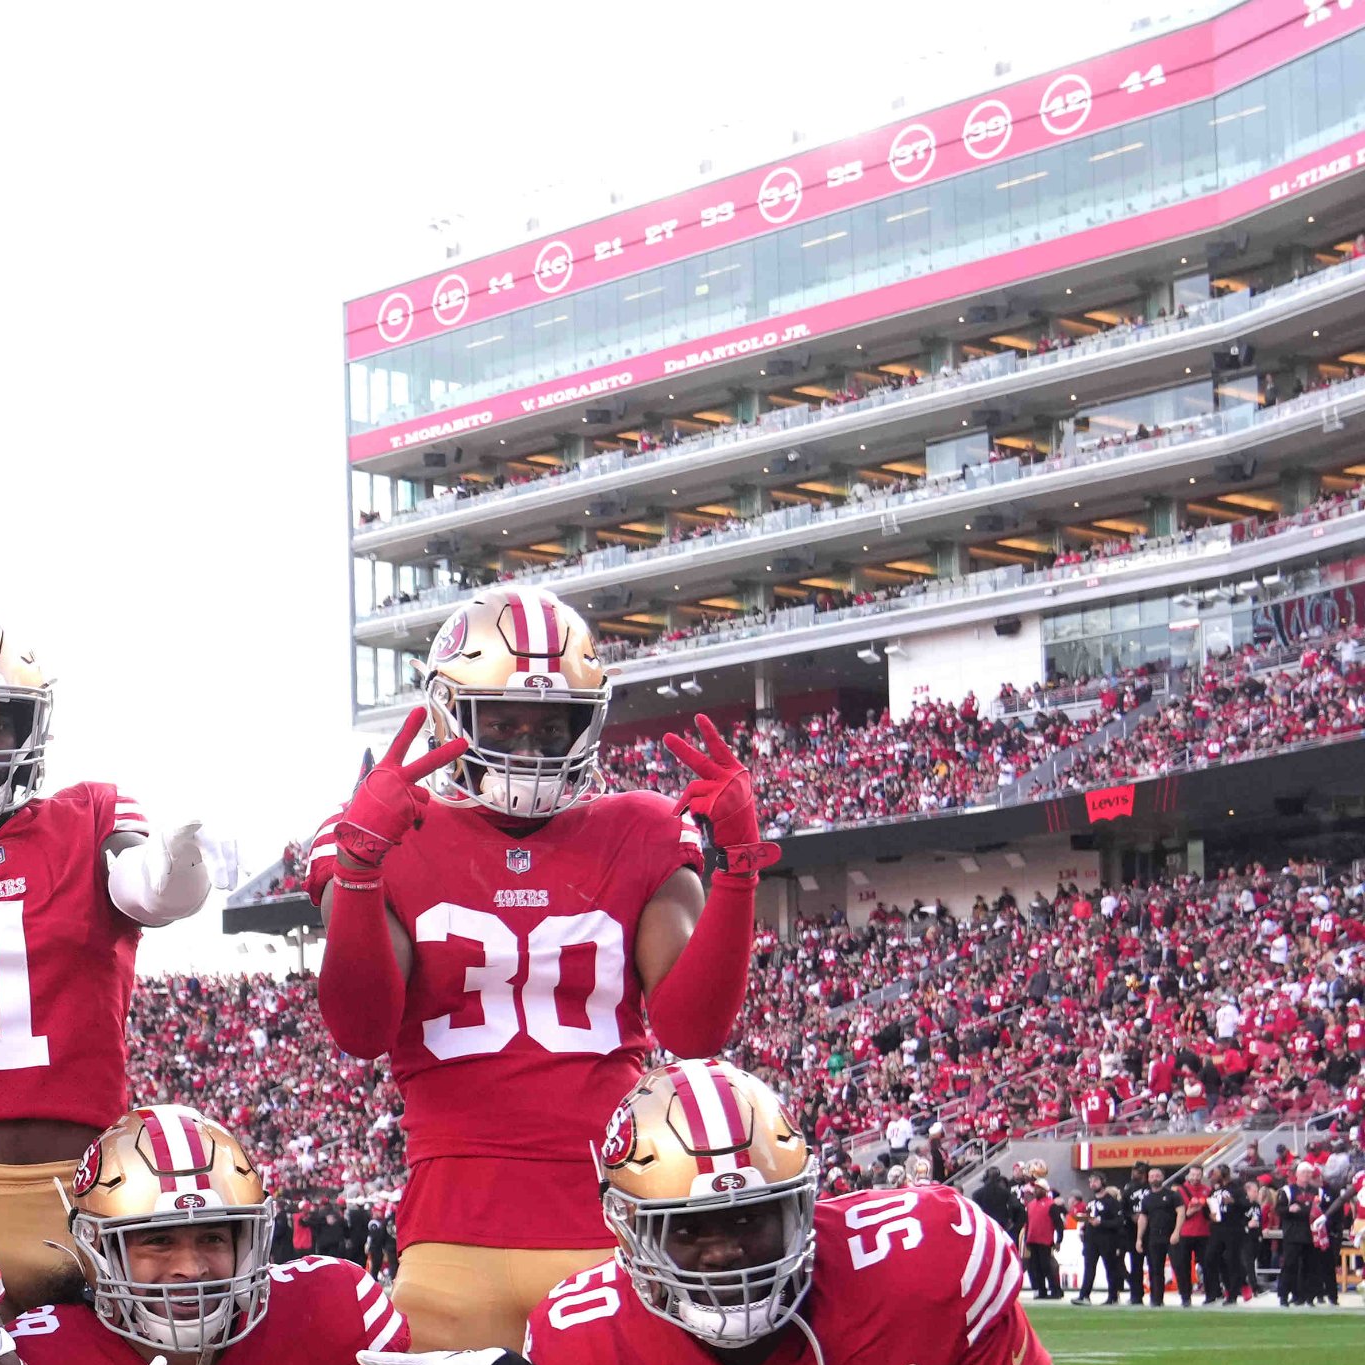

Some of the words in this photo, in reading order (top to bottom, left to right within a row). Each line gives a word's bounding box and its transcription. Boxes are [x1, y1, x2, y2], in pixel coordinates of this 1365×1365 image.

[1119, 64, 1166, 94] 44
[781, 323, 810, 343] JR.
[533, 371, 633, 409] MORABITO
[404, 410, 493, 446] MORABITO
[493, 889, 549, 907] 49ERS
[415, 901, 625, 1061] 30
[1087, 1096, 1099, 1110] 13
[843, 1191, 924, 1271] 50
[547, 1260, 621, 1331] 50
